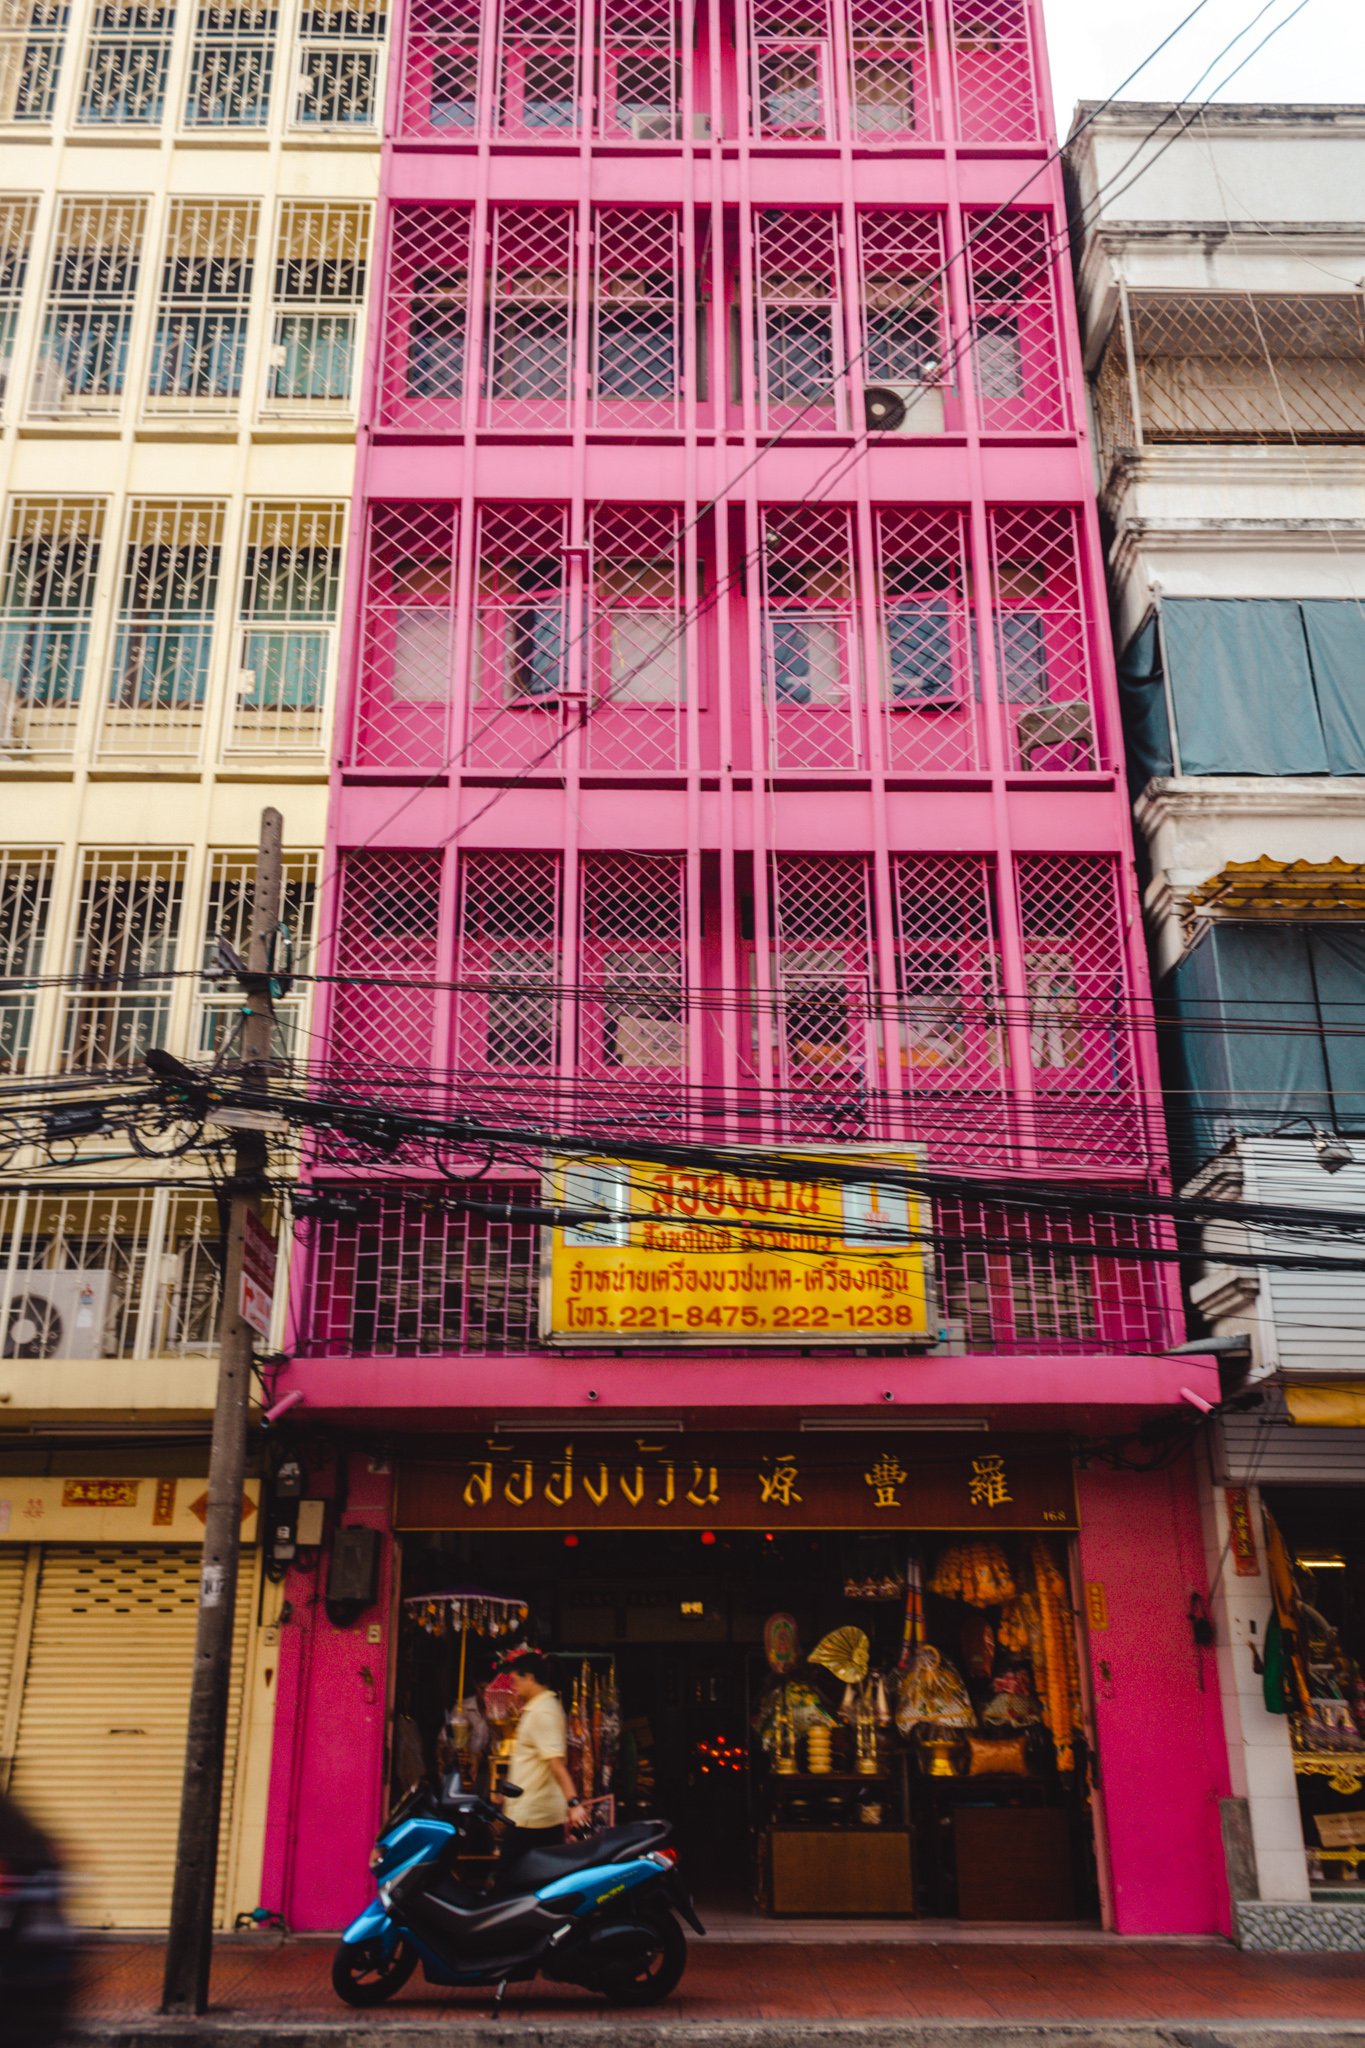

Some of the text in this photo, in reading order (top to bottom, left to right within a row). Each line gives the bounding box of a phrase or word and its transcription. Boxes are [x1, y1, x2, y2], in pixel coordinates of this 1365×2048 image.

[566, 1297, 913, 1328] โทร. 221-8475, 222-1238
[1042, 1511, 1066, 1522] 168
